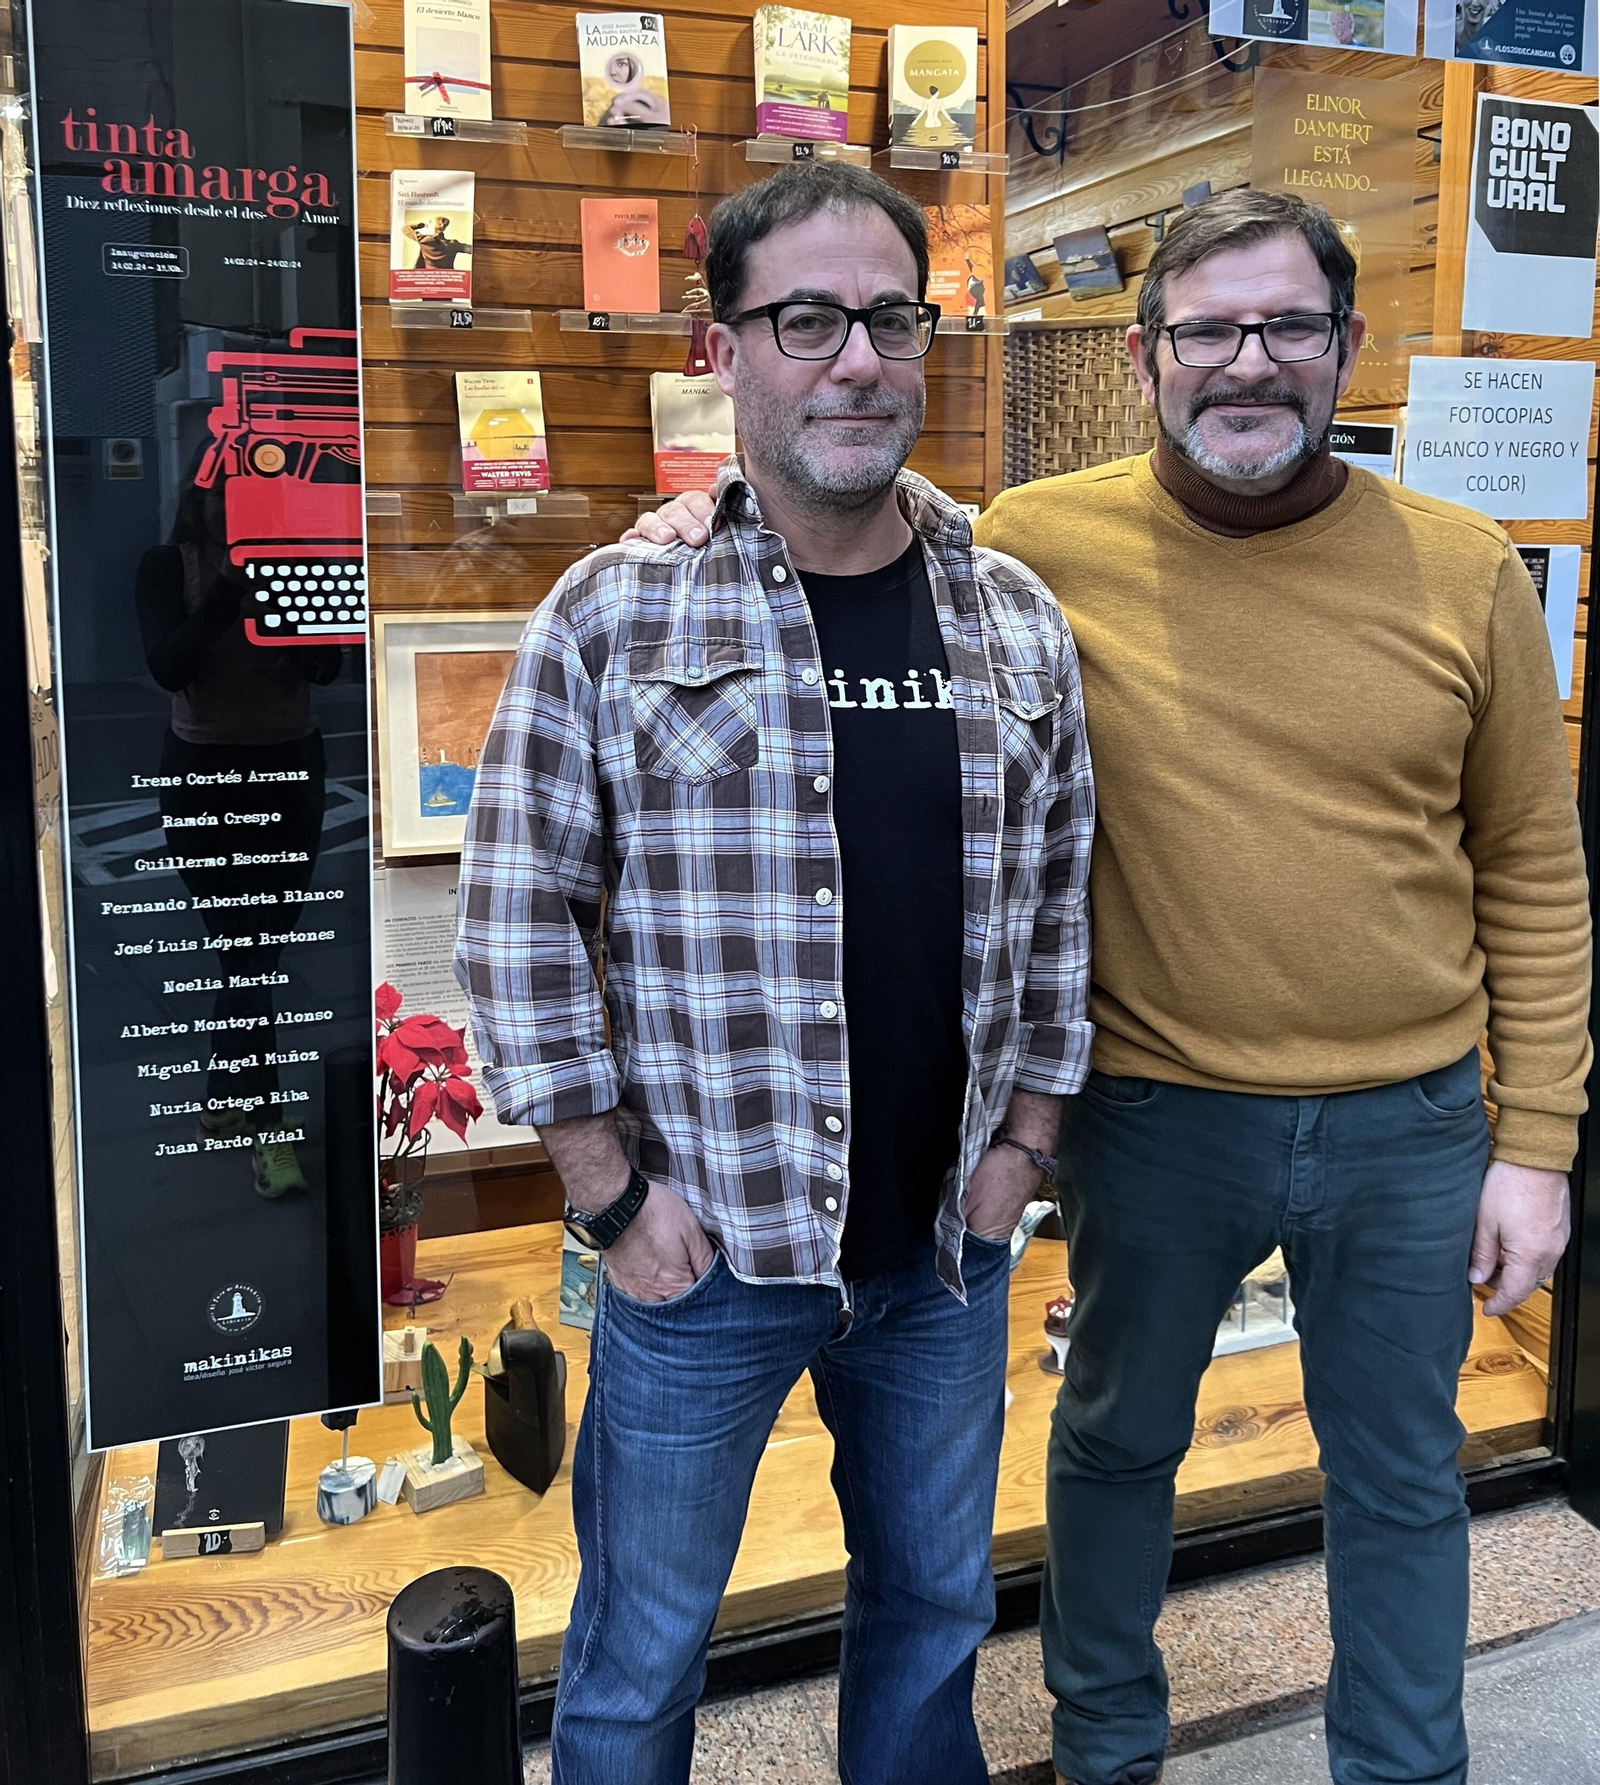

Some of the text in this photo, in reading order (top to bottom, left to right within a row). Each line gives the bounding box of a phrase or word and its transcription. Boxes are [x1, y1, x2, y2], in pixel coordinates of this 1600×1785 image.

[426, 7, 455, 16] desierto
[457, 10, 480, 20] blanco
[586, 24, 602, 35] LA
[586, 34, 660, 46] MUDANZA
[790, 20, 828, 34] SARAH
[778, 28, 838, 56] LARK
[1306, 93, 1367, 120] ELINOR
[60, 107, 196, 159] tinta
[1294, 117, 1374, 146] DAMMERT
[1490, 114, 1572, 152] BONO
[1313, 144, 1352, 166] ESTÁ
[1488, 147, 1566, 182] CULT
[101, 158, 337, 219] amarga
[1487, 178, 1566, 214] URAL
[66, 195, 100, 210] Diez
[103, 198, 182, 216] reflexiones
[184, 203, 222, 218] desde
[225, 204, 238, 219] el
[301, 210, 340, 225] Amor
[1464, 372, 1543, 390] SE HACEN
[1449, 406, 1553, 425] FOTOCOPIAS
[1416, 439, 1580, 462] (BLANCO Y NEGRO Y
[480, 470, 510, 478] WALTER
[1466, 474, 1526, 495] COLOR)
[131, 770, 310, 788] Irene Cortés Arranz
[162, 811, 282, 828] Ramón Crespo
[134, 850, 310, 872] Guillermo Escoriza
[101, 889, 345, 916] Fernando Labordeta Blanco
[114, 930, 336, 956] José Luis López Bretones
[163, 971, 290, 994] Noelia Martín
[120, 1010, 334, 1038] Alberto Montoya Alonso
[138, 1050, 320, 1081] Miguel Ángel Muñoz
[150, 1090, 310, 1116] Nuria Ortega Riba
[154, 1128, 306, 1156] Juan Pardo Vidal
[184, 1346, 292, 1374] makinikas
[267, 1359, 292, 1368] segura
